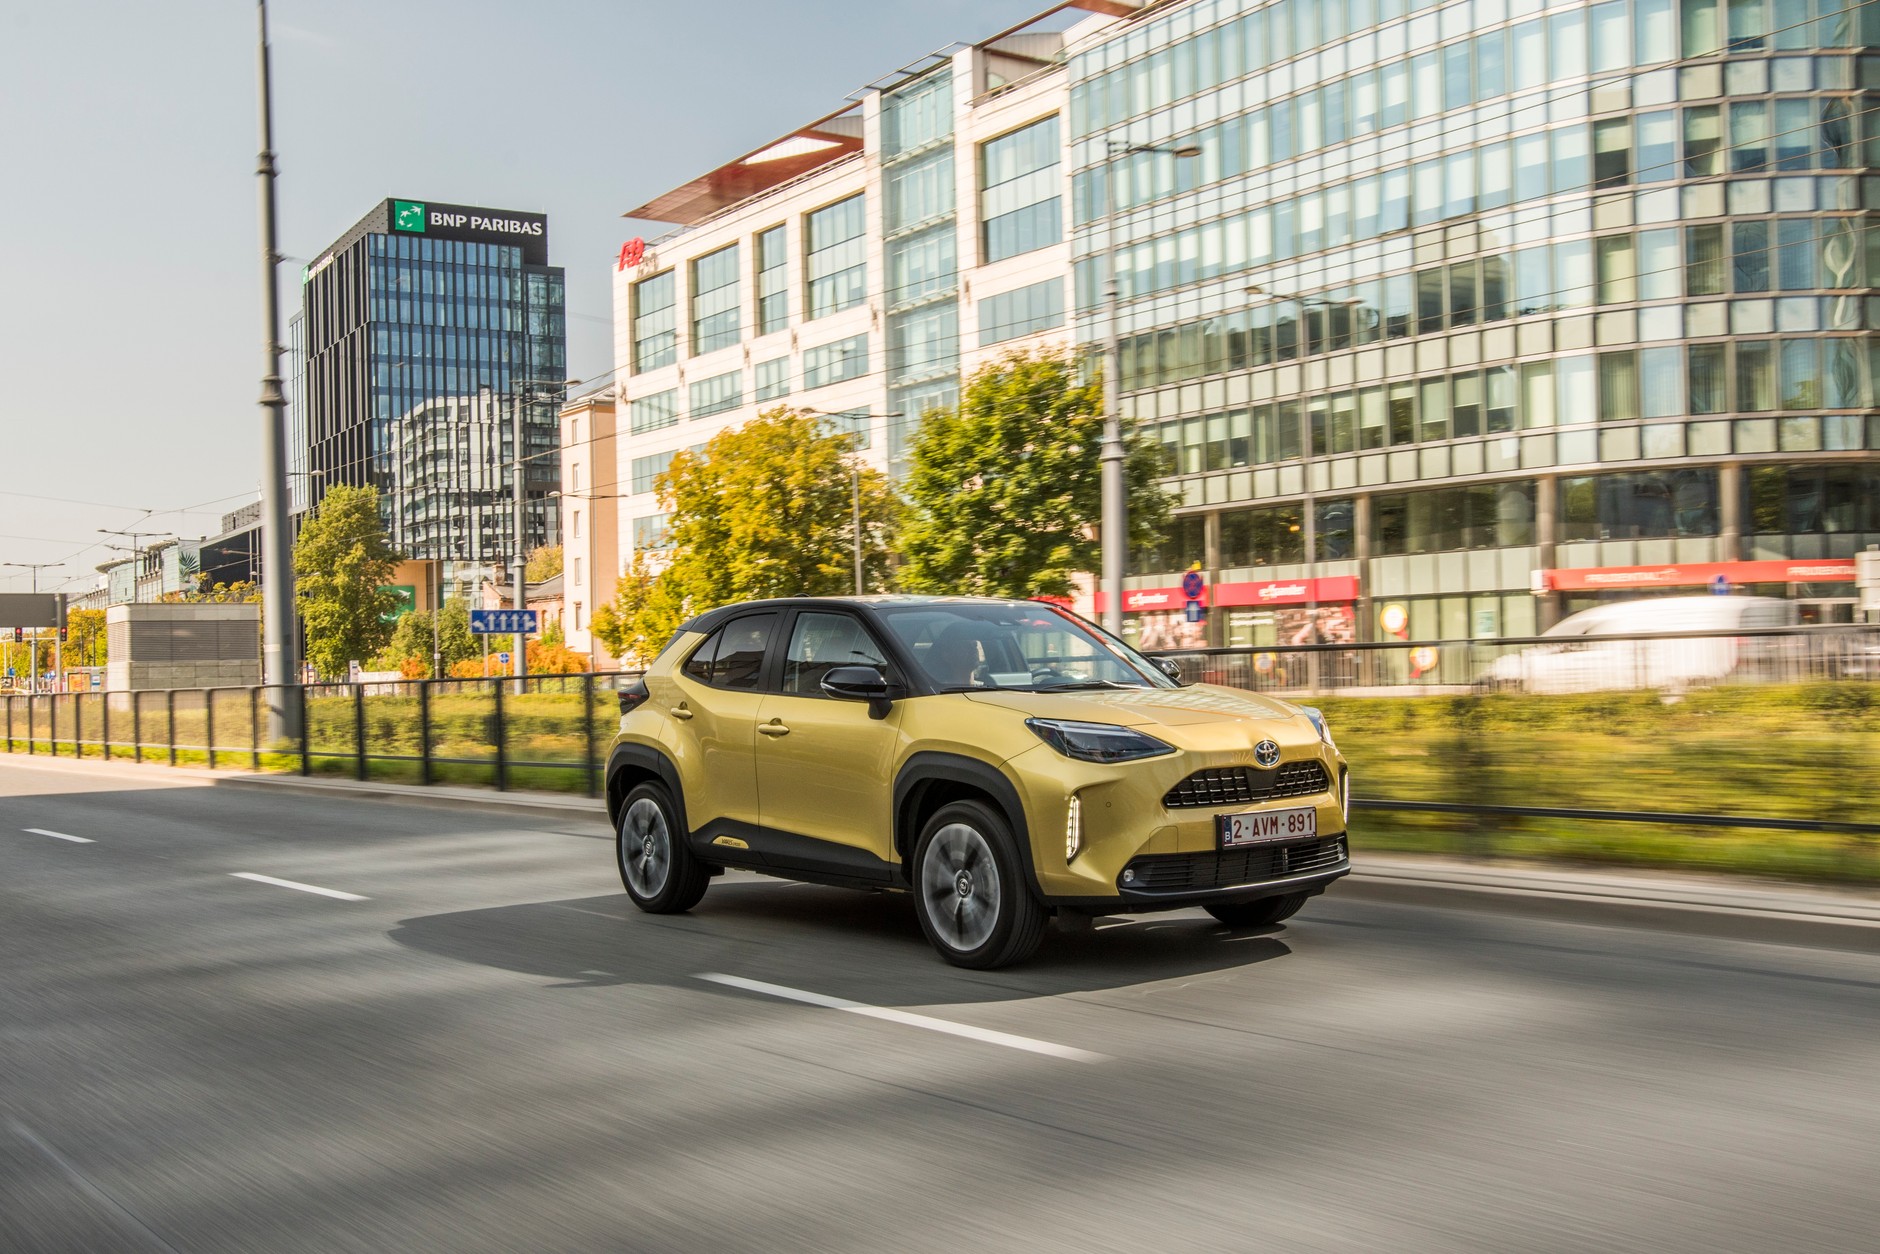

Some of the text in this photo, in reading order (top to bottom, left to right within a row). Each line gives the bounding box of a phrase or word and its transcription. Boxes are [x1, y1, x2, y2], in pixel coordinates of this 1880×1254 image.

[430, 212, 543, 235] BNP PARIBAS
[1225, 813, 1312, 840] B 2-AVM-891
